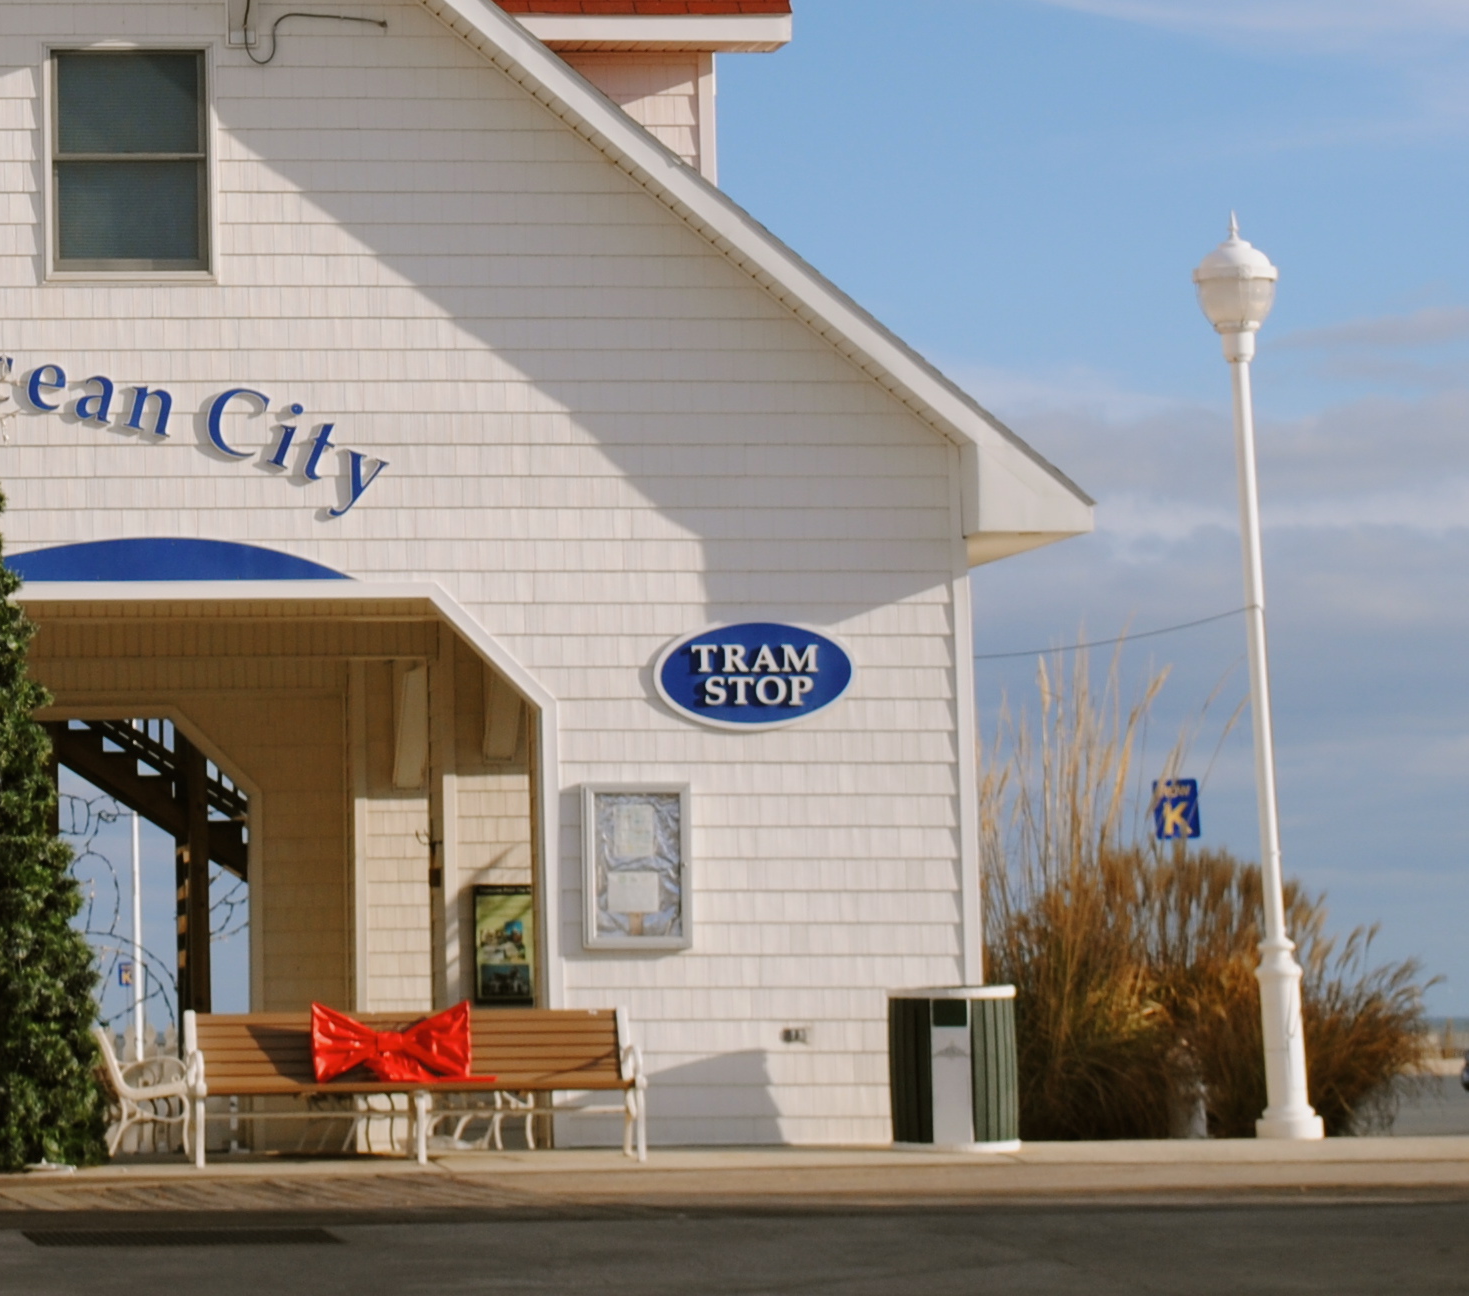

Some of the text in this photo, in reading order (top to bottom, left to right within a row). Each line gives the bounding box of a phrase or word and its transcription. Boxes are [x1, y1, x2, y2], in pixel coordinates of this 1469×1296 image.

[205, 388, 389, 518] City
[691, 644, 819, 673] TRAM
[704, 675, 814, 706] STOP
[1162, 801, 1193, 836] K
